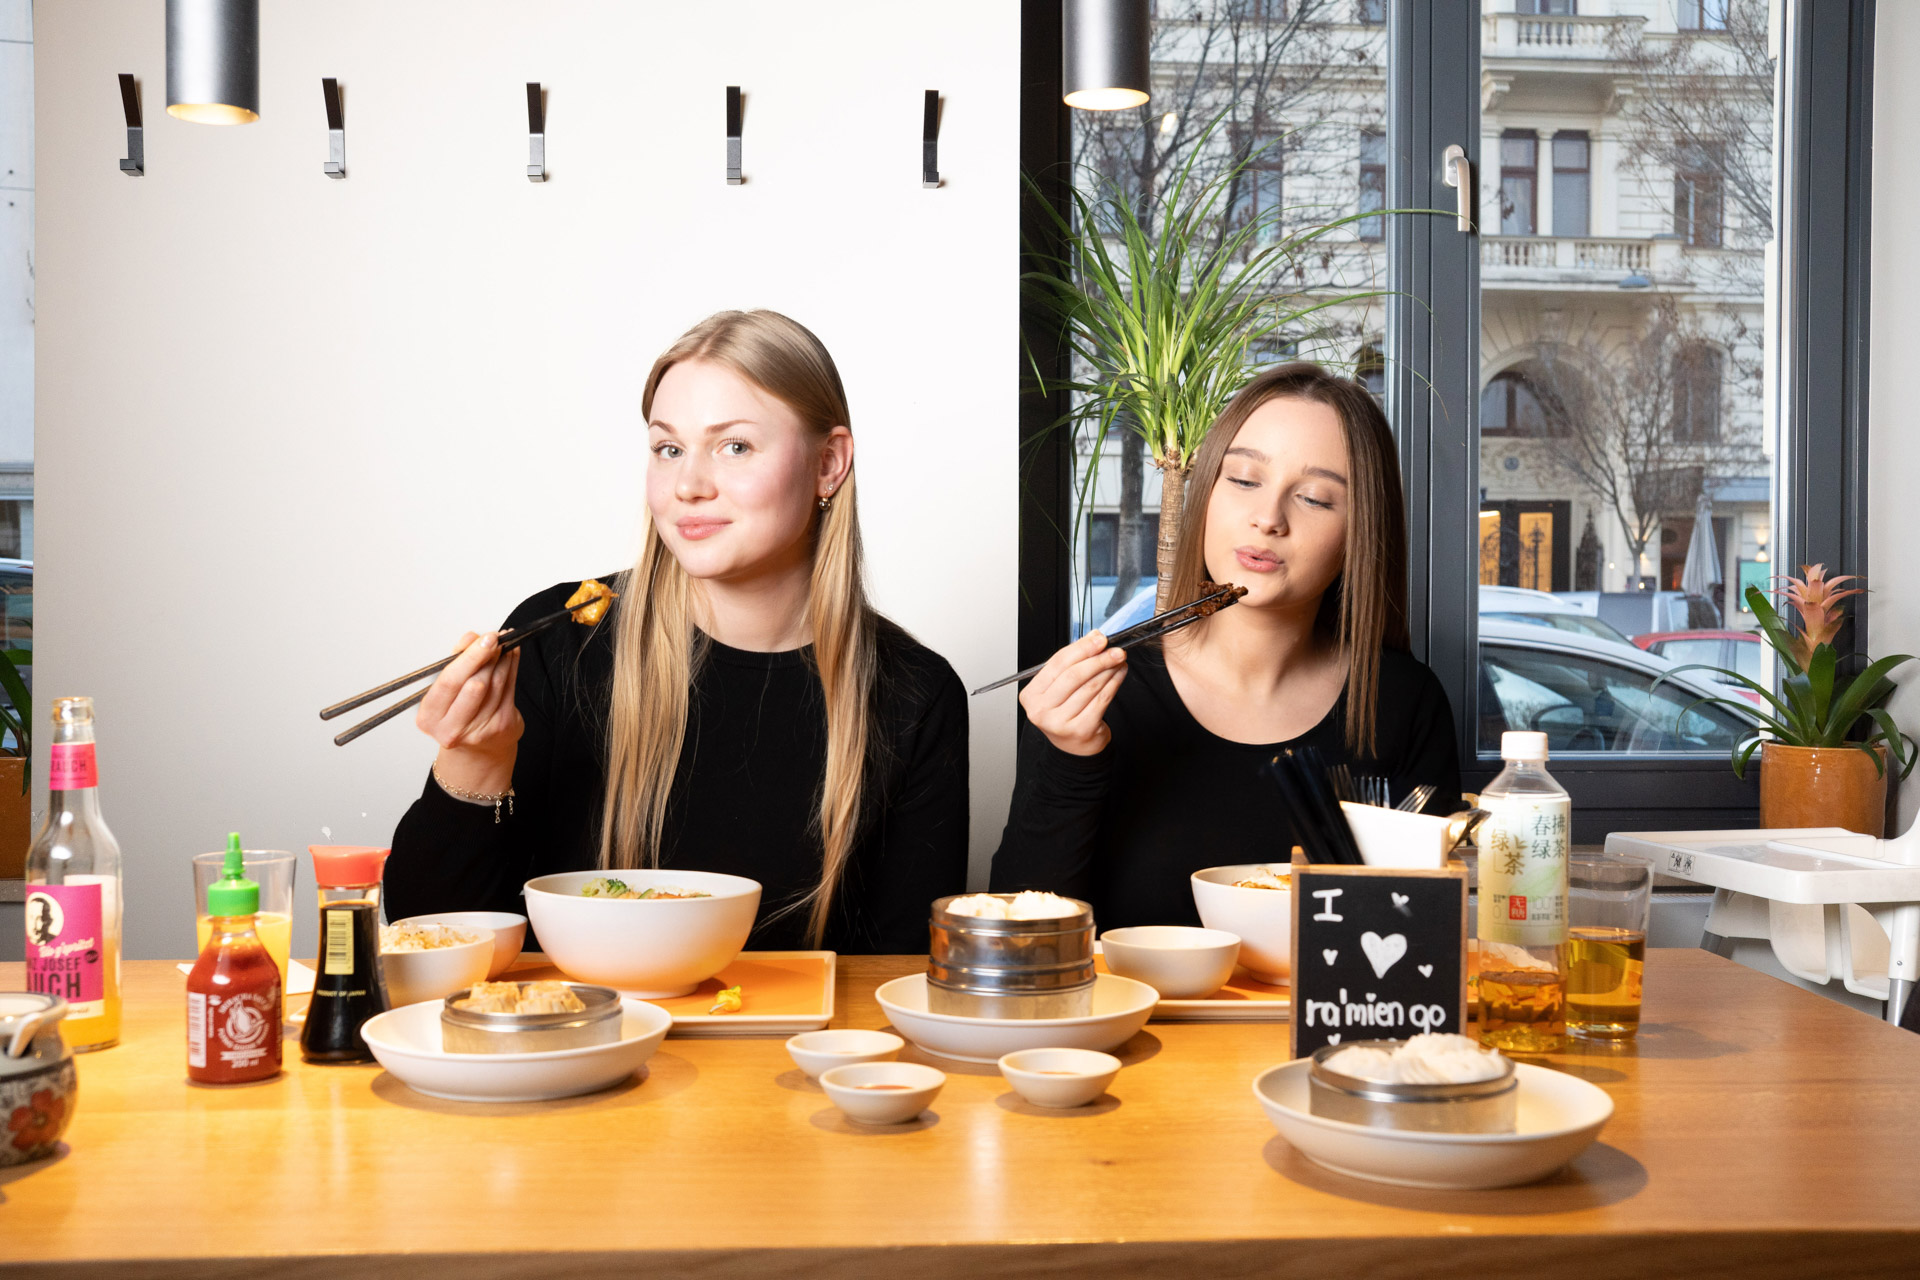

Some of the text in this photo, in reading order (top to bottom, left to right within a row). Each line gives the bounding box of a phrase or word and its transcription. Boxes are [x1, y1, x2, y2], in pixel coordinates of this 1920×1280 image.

[1312, 888, 1343, 922] I
[42, 957, 81, 971] JOSEF
[1305, 988, 1404, 1027] ra'mien
